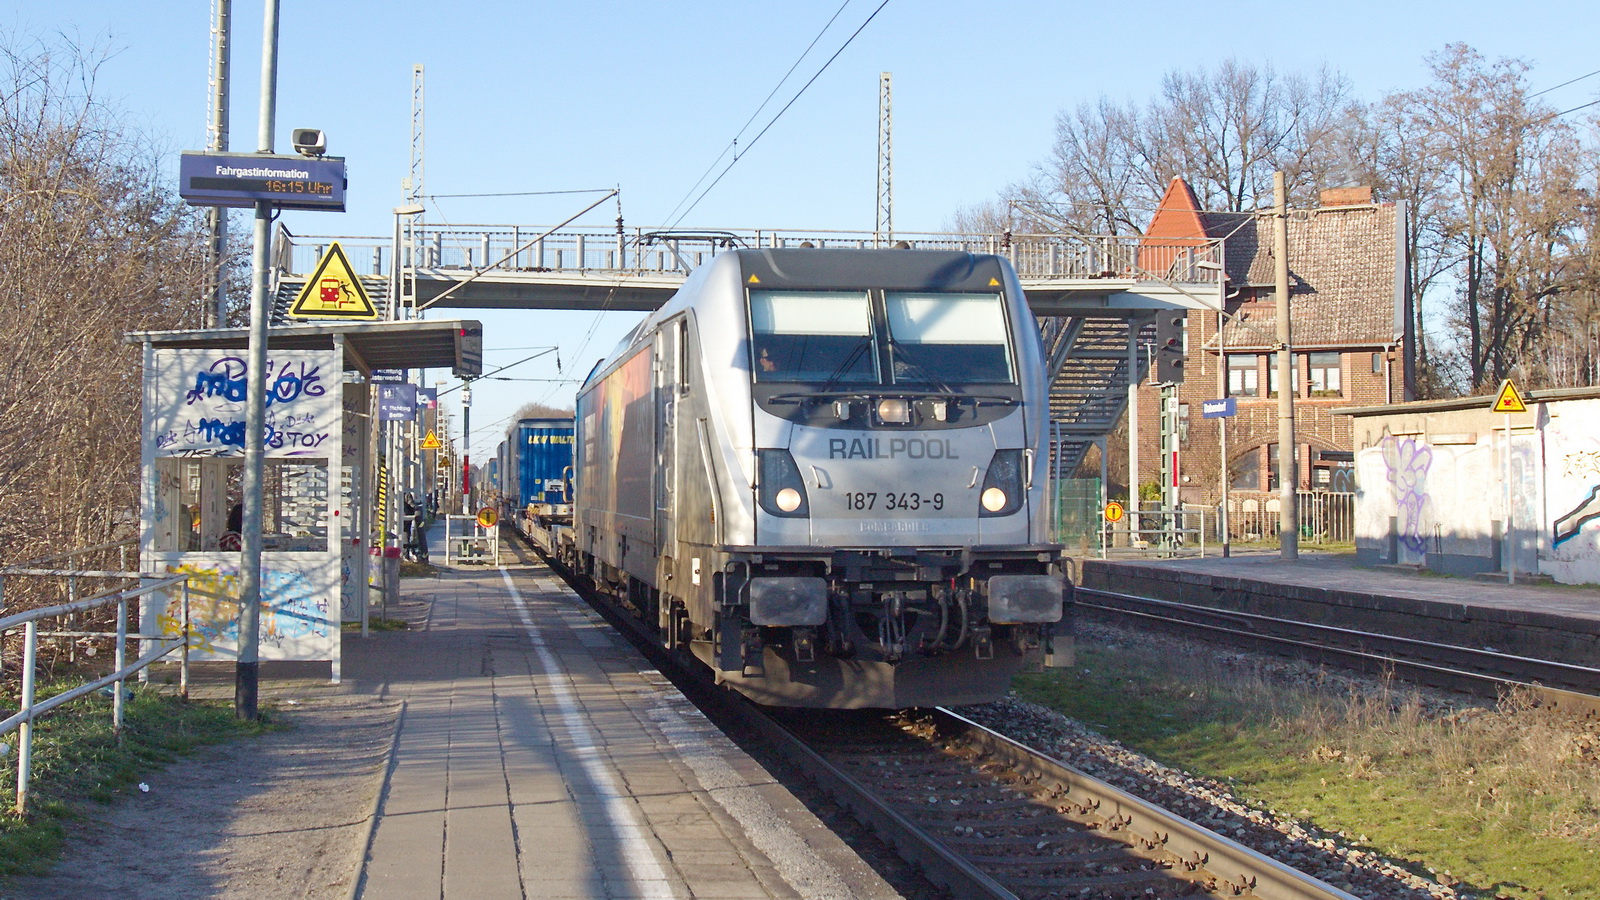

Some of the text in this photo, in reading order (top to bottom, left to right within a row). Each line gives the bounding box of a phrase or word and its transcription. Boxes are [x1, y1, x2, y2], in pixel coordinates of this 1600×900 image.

[216, 165, 308, 178] Fahrgastinformation
[265, 180, 333, 194] 16:15 Uhr
[528, 435, 548, 444] LKW
[829, 438, 959, 460] RAILPOOL
[846, 492, 945, 511] 187 343-9
[860, 522, 928, 532] BOMBARDIER
